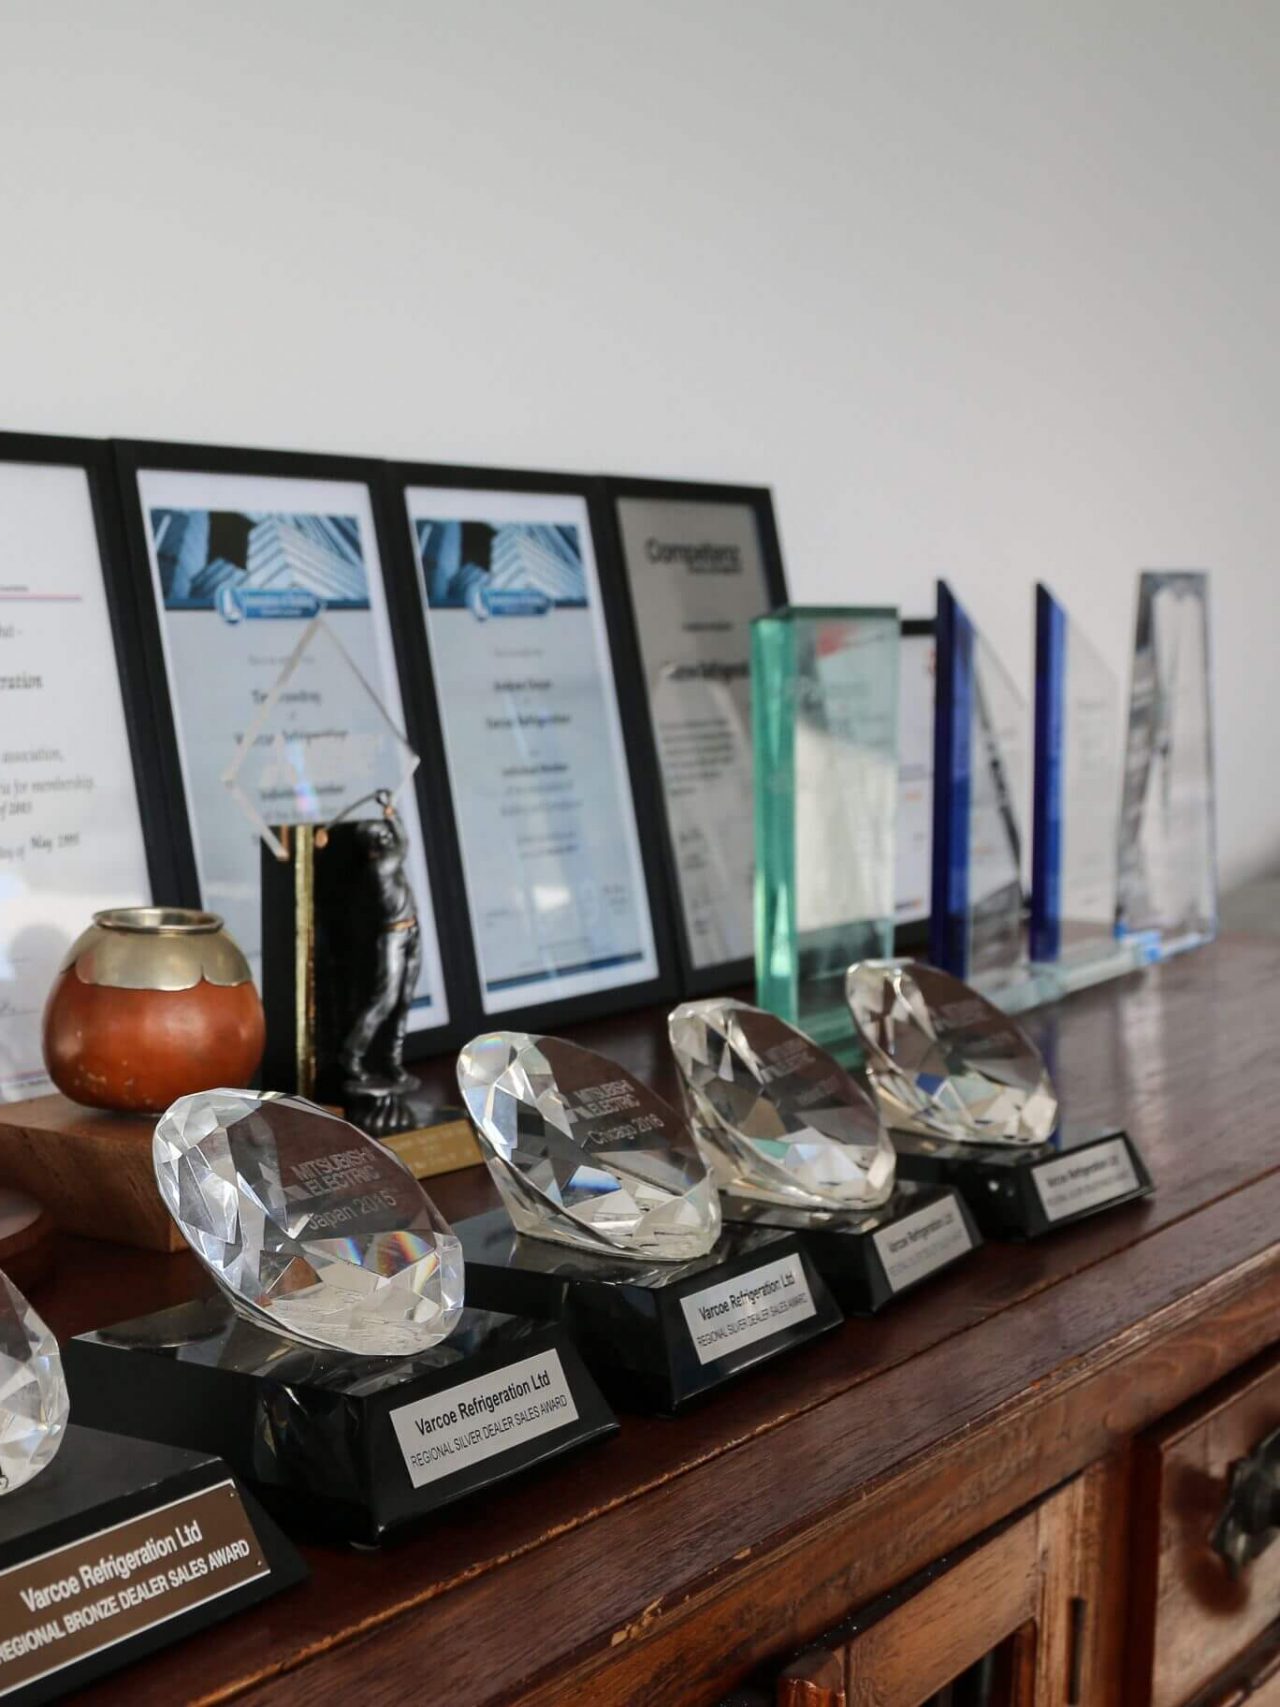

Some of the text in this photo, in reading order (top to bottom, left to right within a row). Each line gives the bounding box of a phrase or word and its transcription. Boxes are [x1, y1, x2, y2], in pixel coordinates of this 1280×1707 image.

[411, 1394, 568, 1467] REGIONAL SILVER DEALER SALES AWARD
[414, 1370, 551, 1436] Varcoe Refrigeration Ltd
[20, 1520, 203, 1612] Varcoe Refrigeration Ltd
[65, 1596, 121, 1634] BRONZE
[118, 1575, 169, 1611] DEALER
[169, 1558, 209, 1588] SALES
[207, 1539, 252, 1572] AWARD
